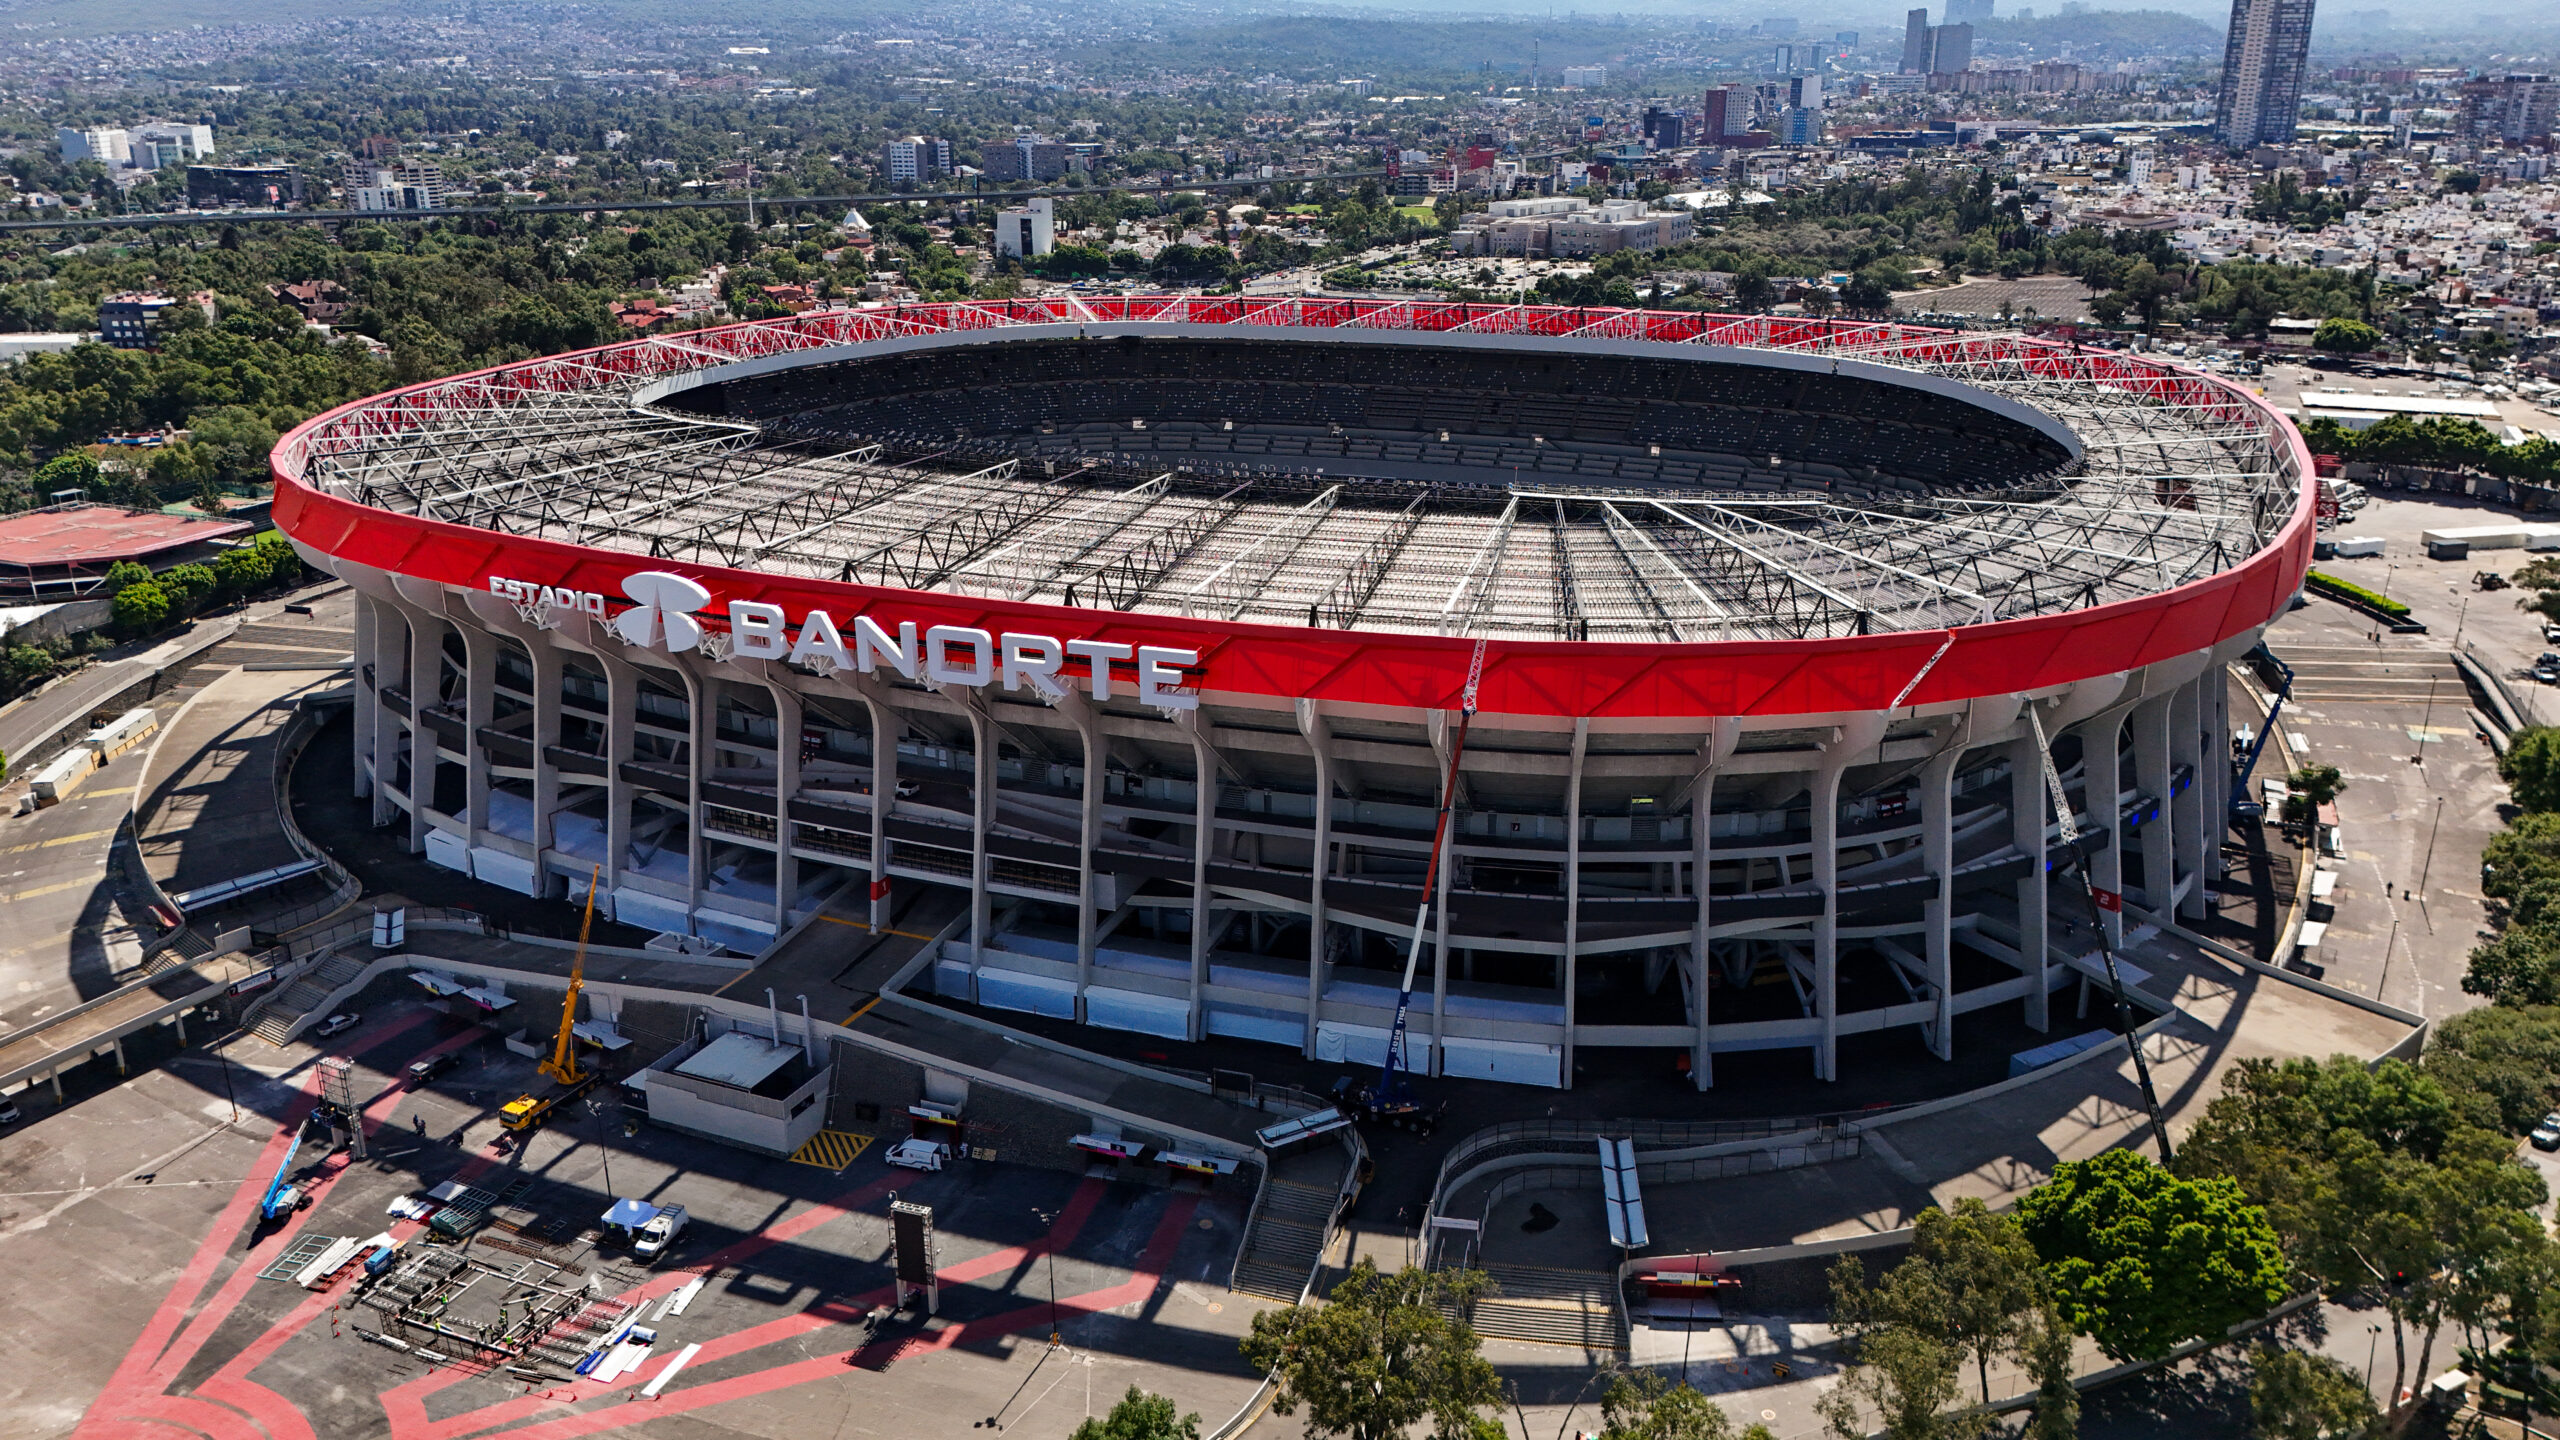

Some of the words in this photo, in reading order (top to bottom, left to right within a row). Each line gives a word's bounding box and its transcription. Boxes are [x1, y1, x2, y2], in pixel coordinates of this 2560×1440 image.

[489, 576, 604, 615] ESTADIO
[729, 601, 1199, 710] BANORTE
[2100, 893, 2110, 905] 2
